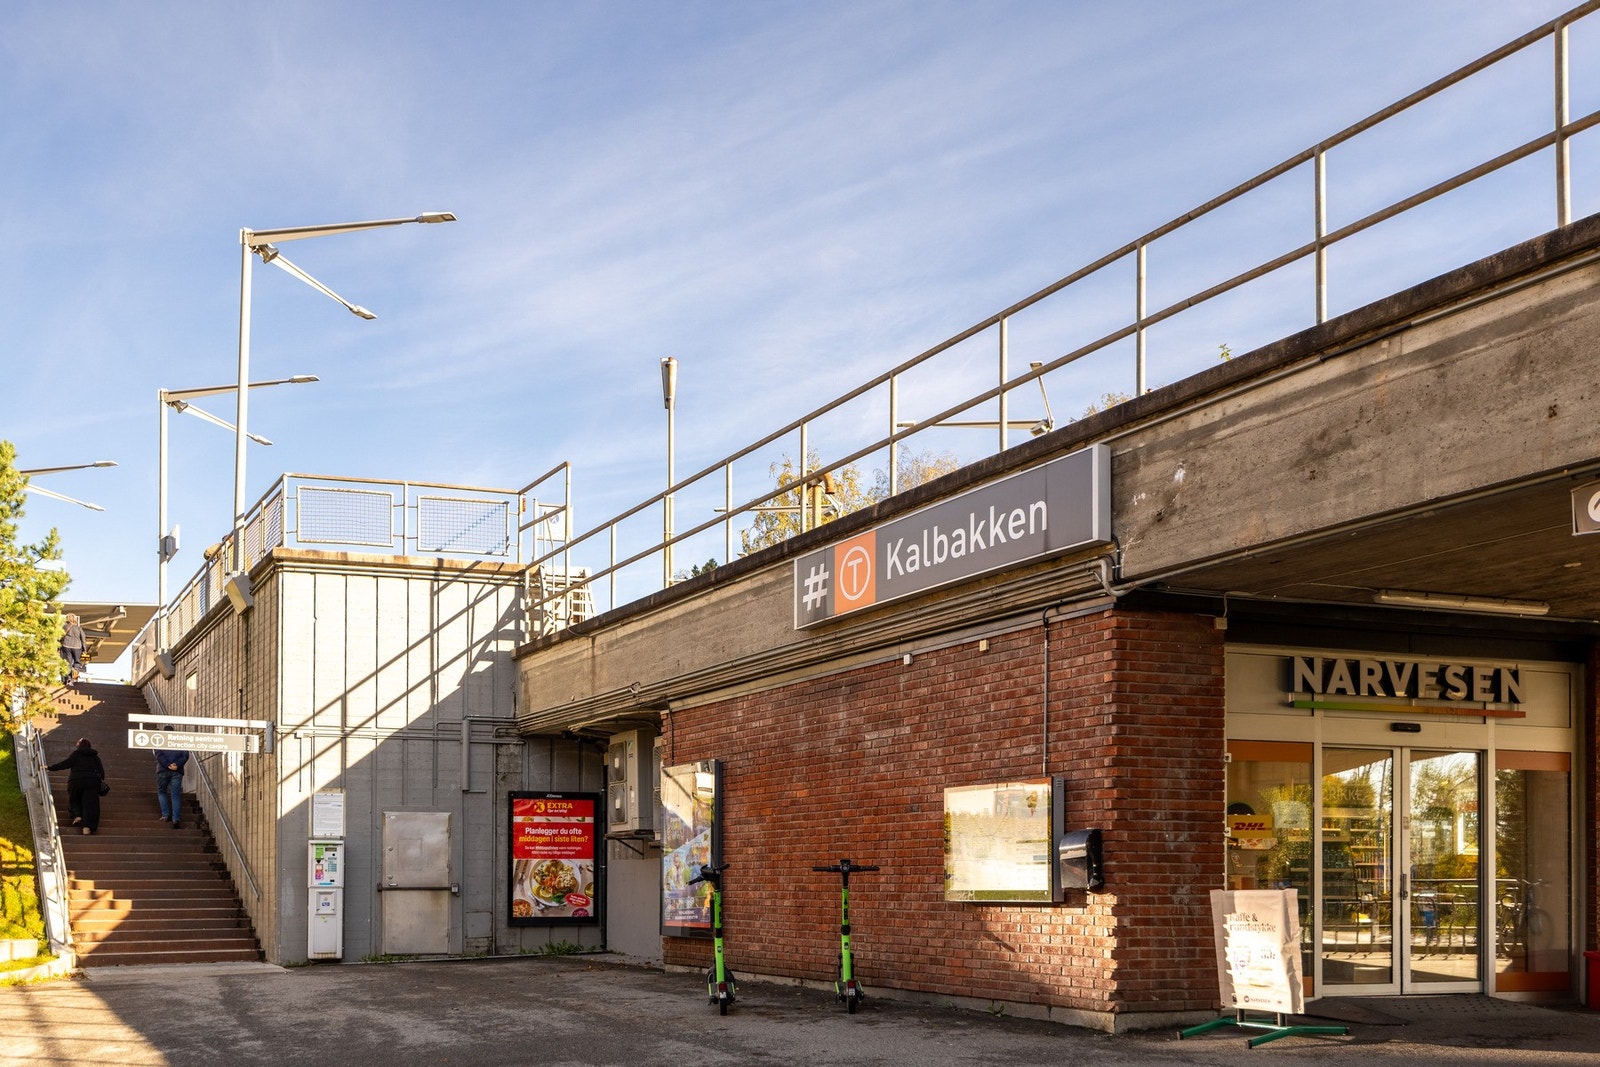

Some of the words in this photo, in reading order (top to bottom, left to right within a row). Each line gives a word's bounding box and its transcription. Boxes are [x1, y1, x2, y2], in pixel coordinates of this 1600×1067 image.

[886, 499, 1048, 581] Kalbakken
[1292, 656, 1526, 704] NARVESEN
[168, 734, 194, 743] Retning
[168, 741, 196, 749] Direction
[196, 743, 208, 751] city
[1233, 822, 1266, 831] DHL
[525, 827, 559, 836] Planlegger
[559, 827, 568, 835] du
[569, 827, 582, 835] ofte
[518, 835, 550, 843] middagen
[1251, 912, 1258, 922] &
